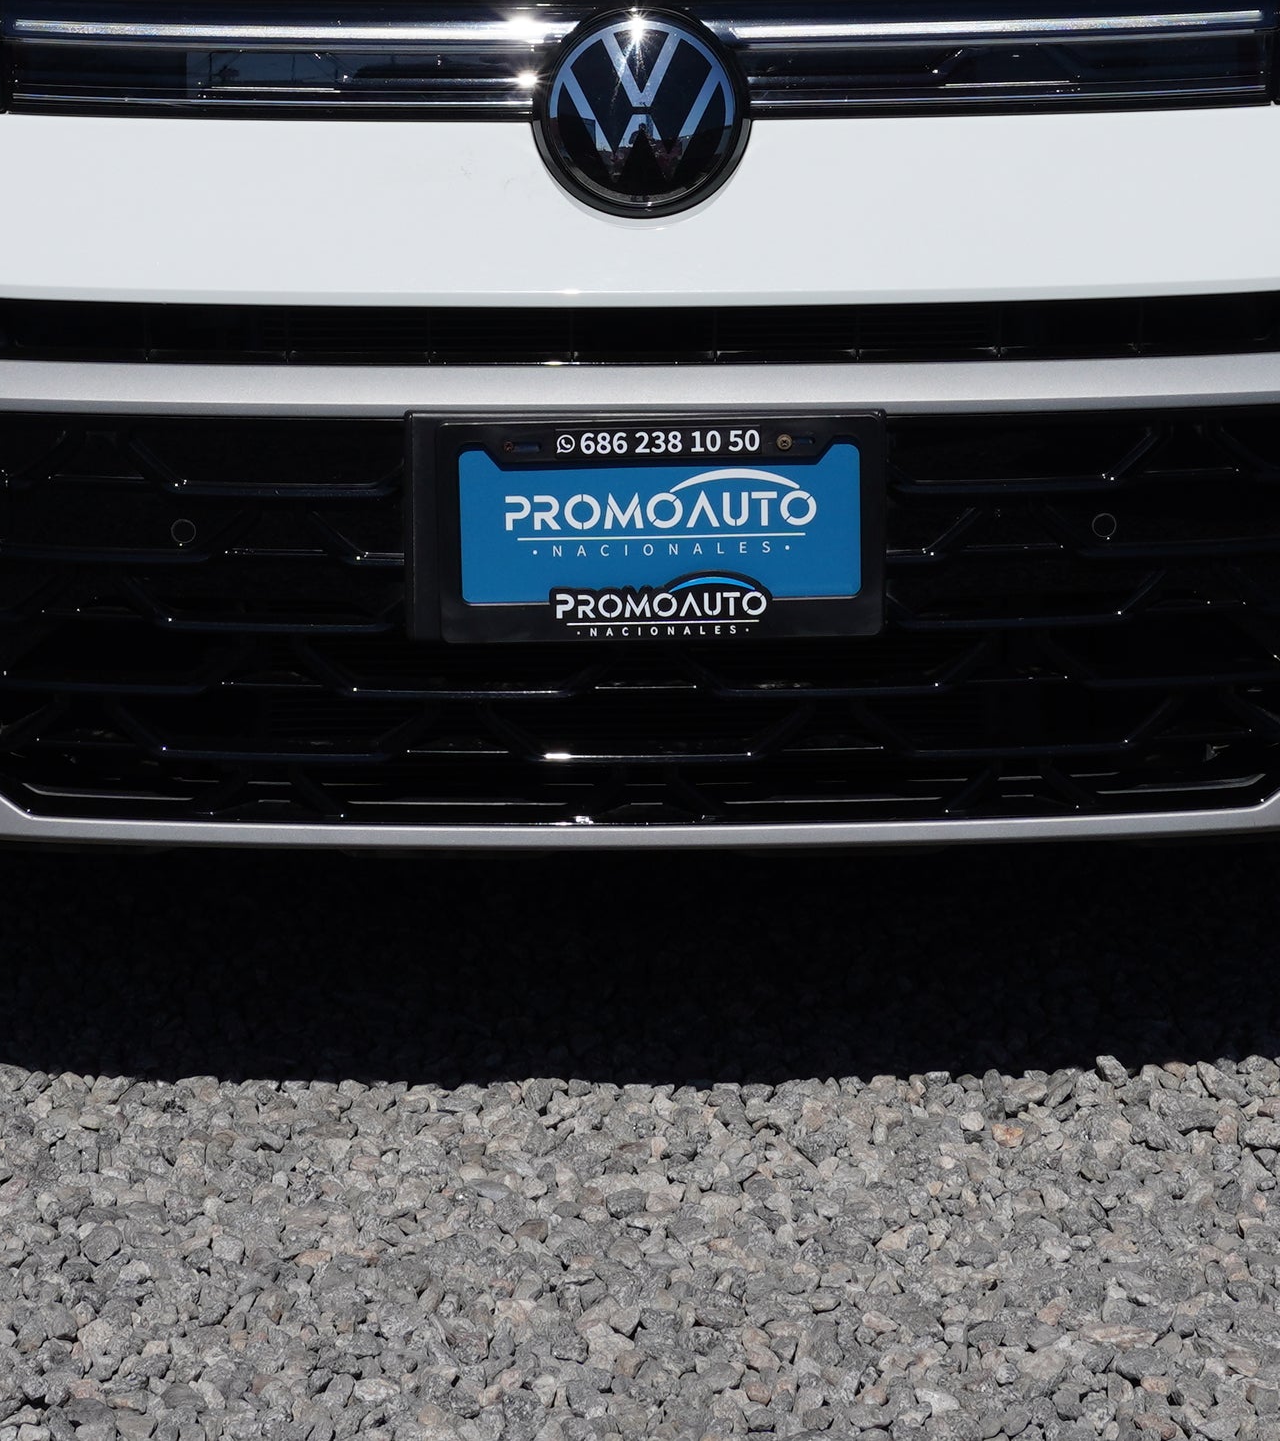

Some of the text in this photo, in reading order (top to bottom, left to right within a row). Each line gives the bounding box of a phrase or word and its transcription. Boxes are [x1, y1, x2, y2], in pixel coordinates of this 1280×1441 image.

[579, 429, 761, 455] 686 238 10 50
[504, 489, 818, 532] PROMOAUTO
[552, 540, 772, 558] NACIONALES
[555, 590, 768, 620] PROMOAUTO
[589, 624, 737, 638] NACIONALES
